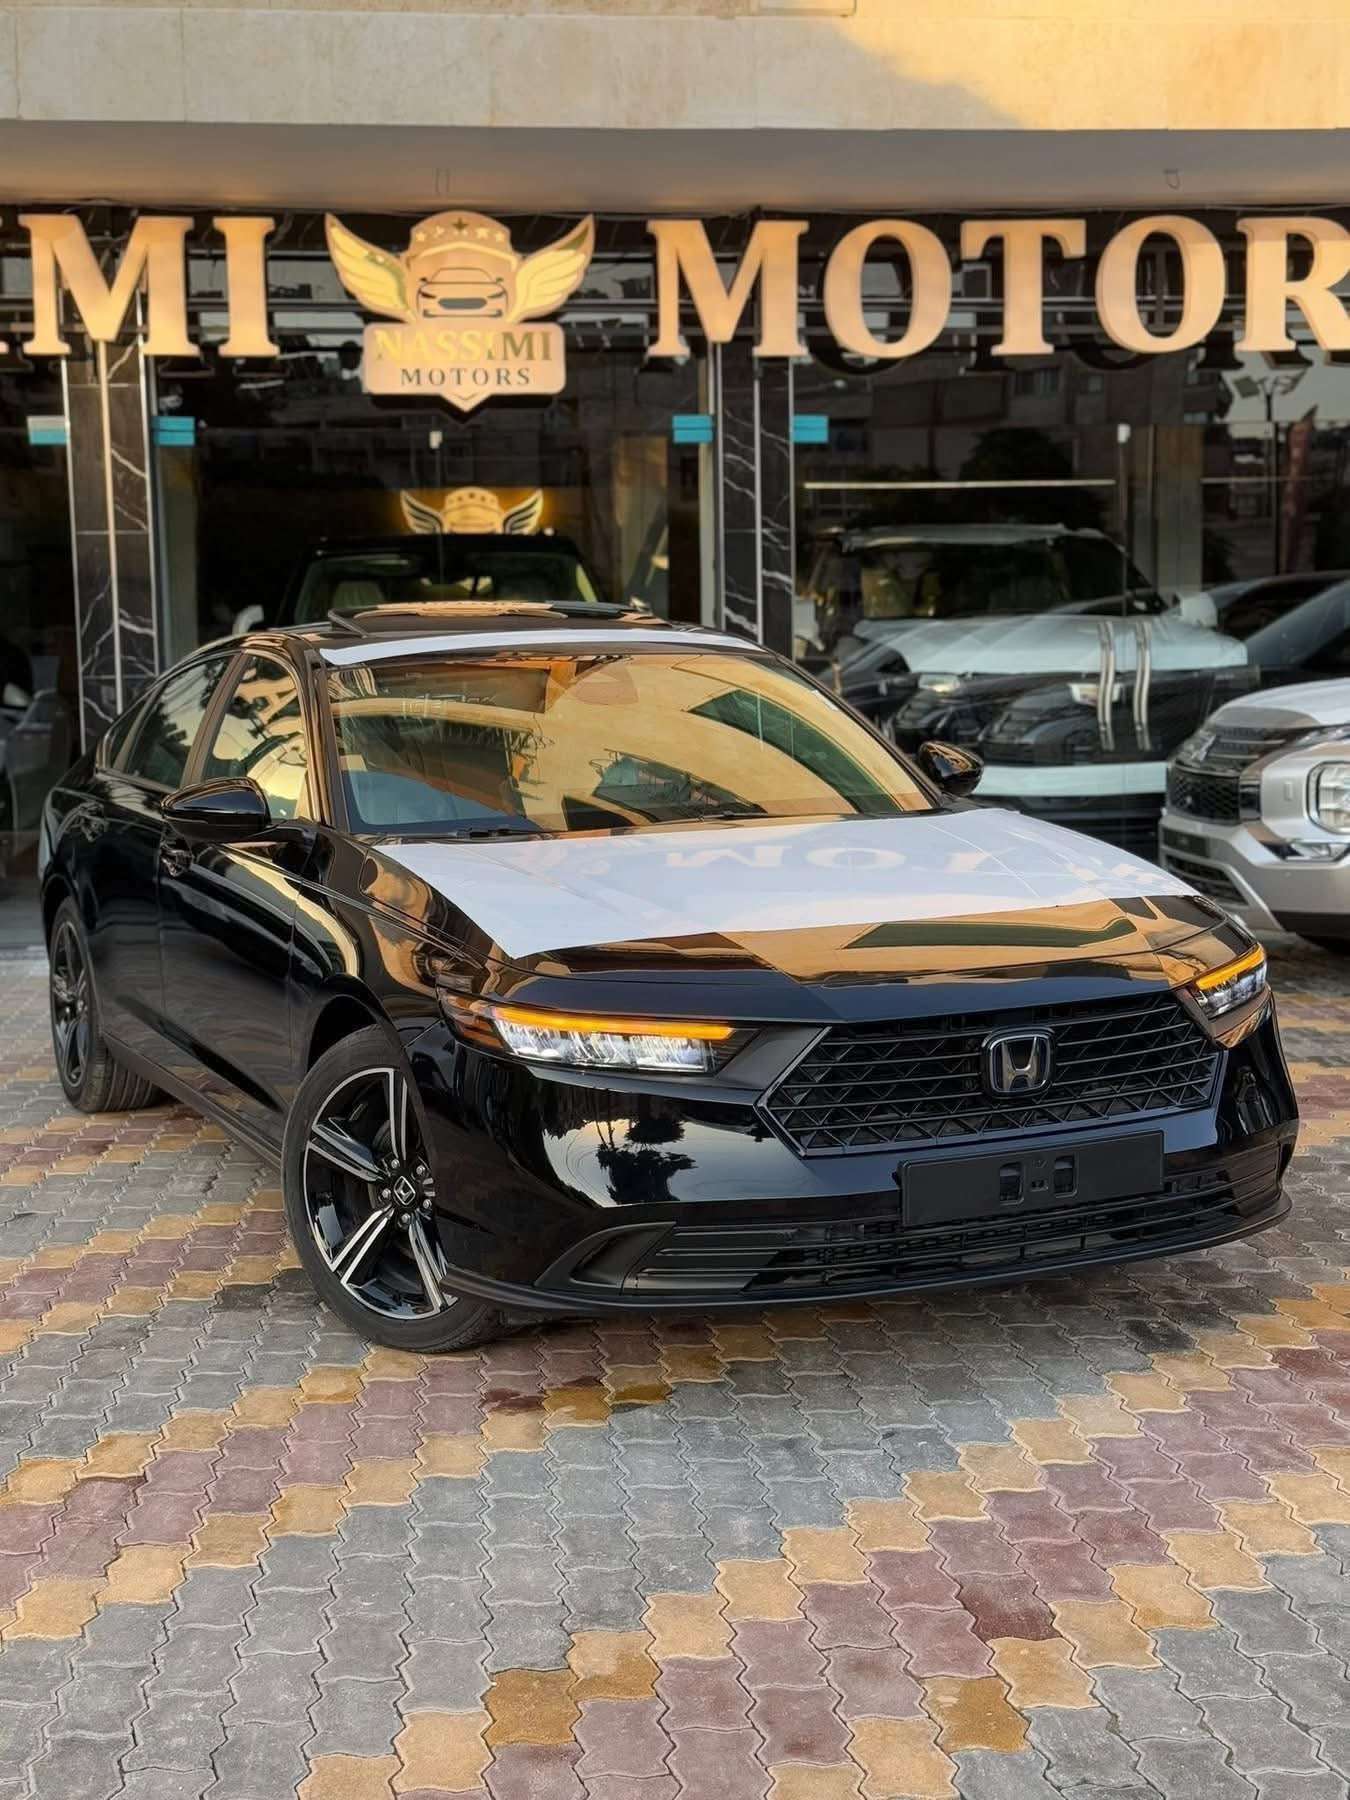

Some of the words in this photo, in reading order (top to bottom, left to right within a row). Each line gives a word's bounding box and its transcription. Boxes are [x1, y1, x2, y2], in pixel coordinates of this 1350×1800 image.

[0, 213, 280, 358] MI
[645, 213, 1350, 359] MOTOR
[374, 329, 552, 362] NASSIMI
[399, 366, 531, 387] MOTORS
